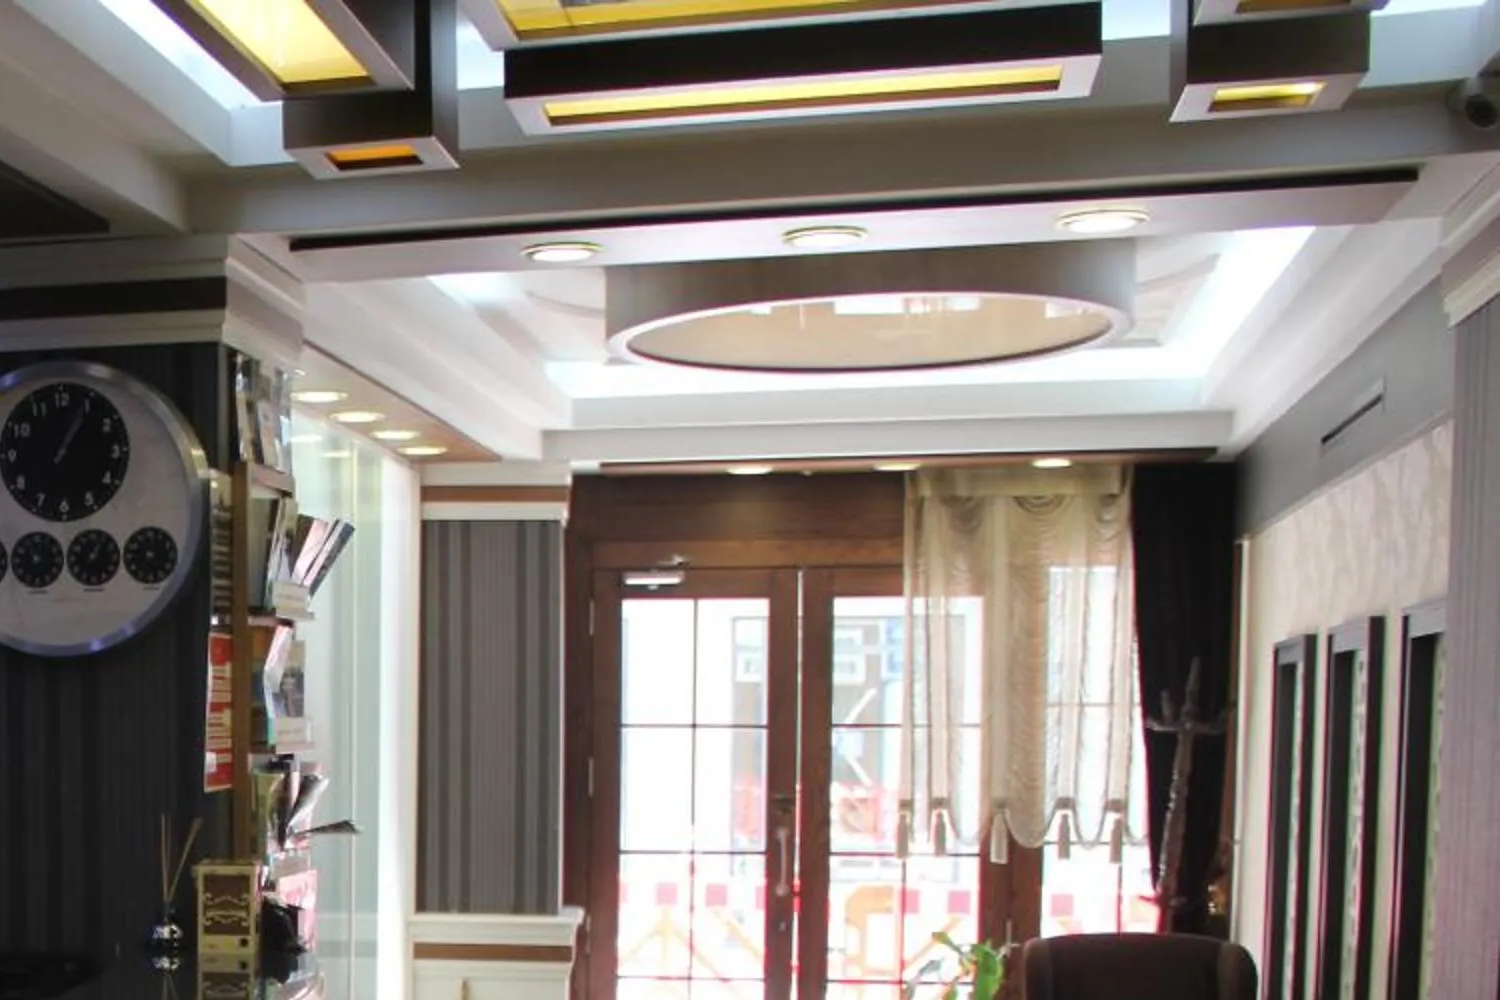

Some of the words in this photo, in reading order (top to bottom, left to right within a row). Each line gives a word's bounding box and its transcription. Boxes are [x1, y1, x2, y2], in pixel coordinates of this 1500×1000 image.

[55, 391, 69, 408] 12
[32, 400, 47, 417] 11
[13, 421, 31, 438] 10
[102, 417, 112, 433] 2
[111, 443, 120, 459] 3
[101, 470, 112, 484] 4
[59, 499, 69, 513] 6
